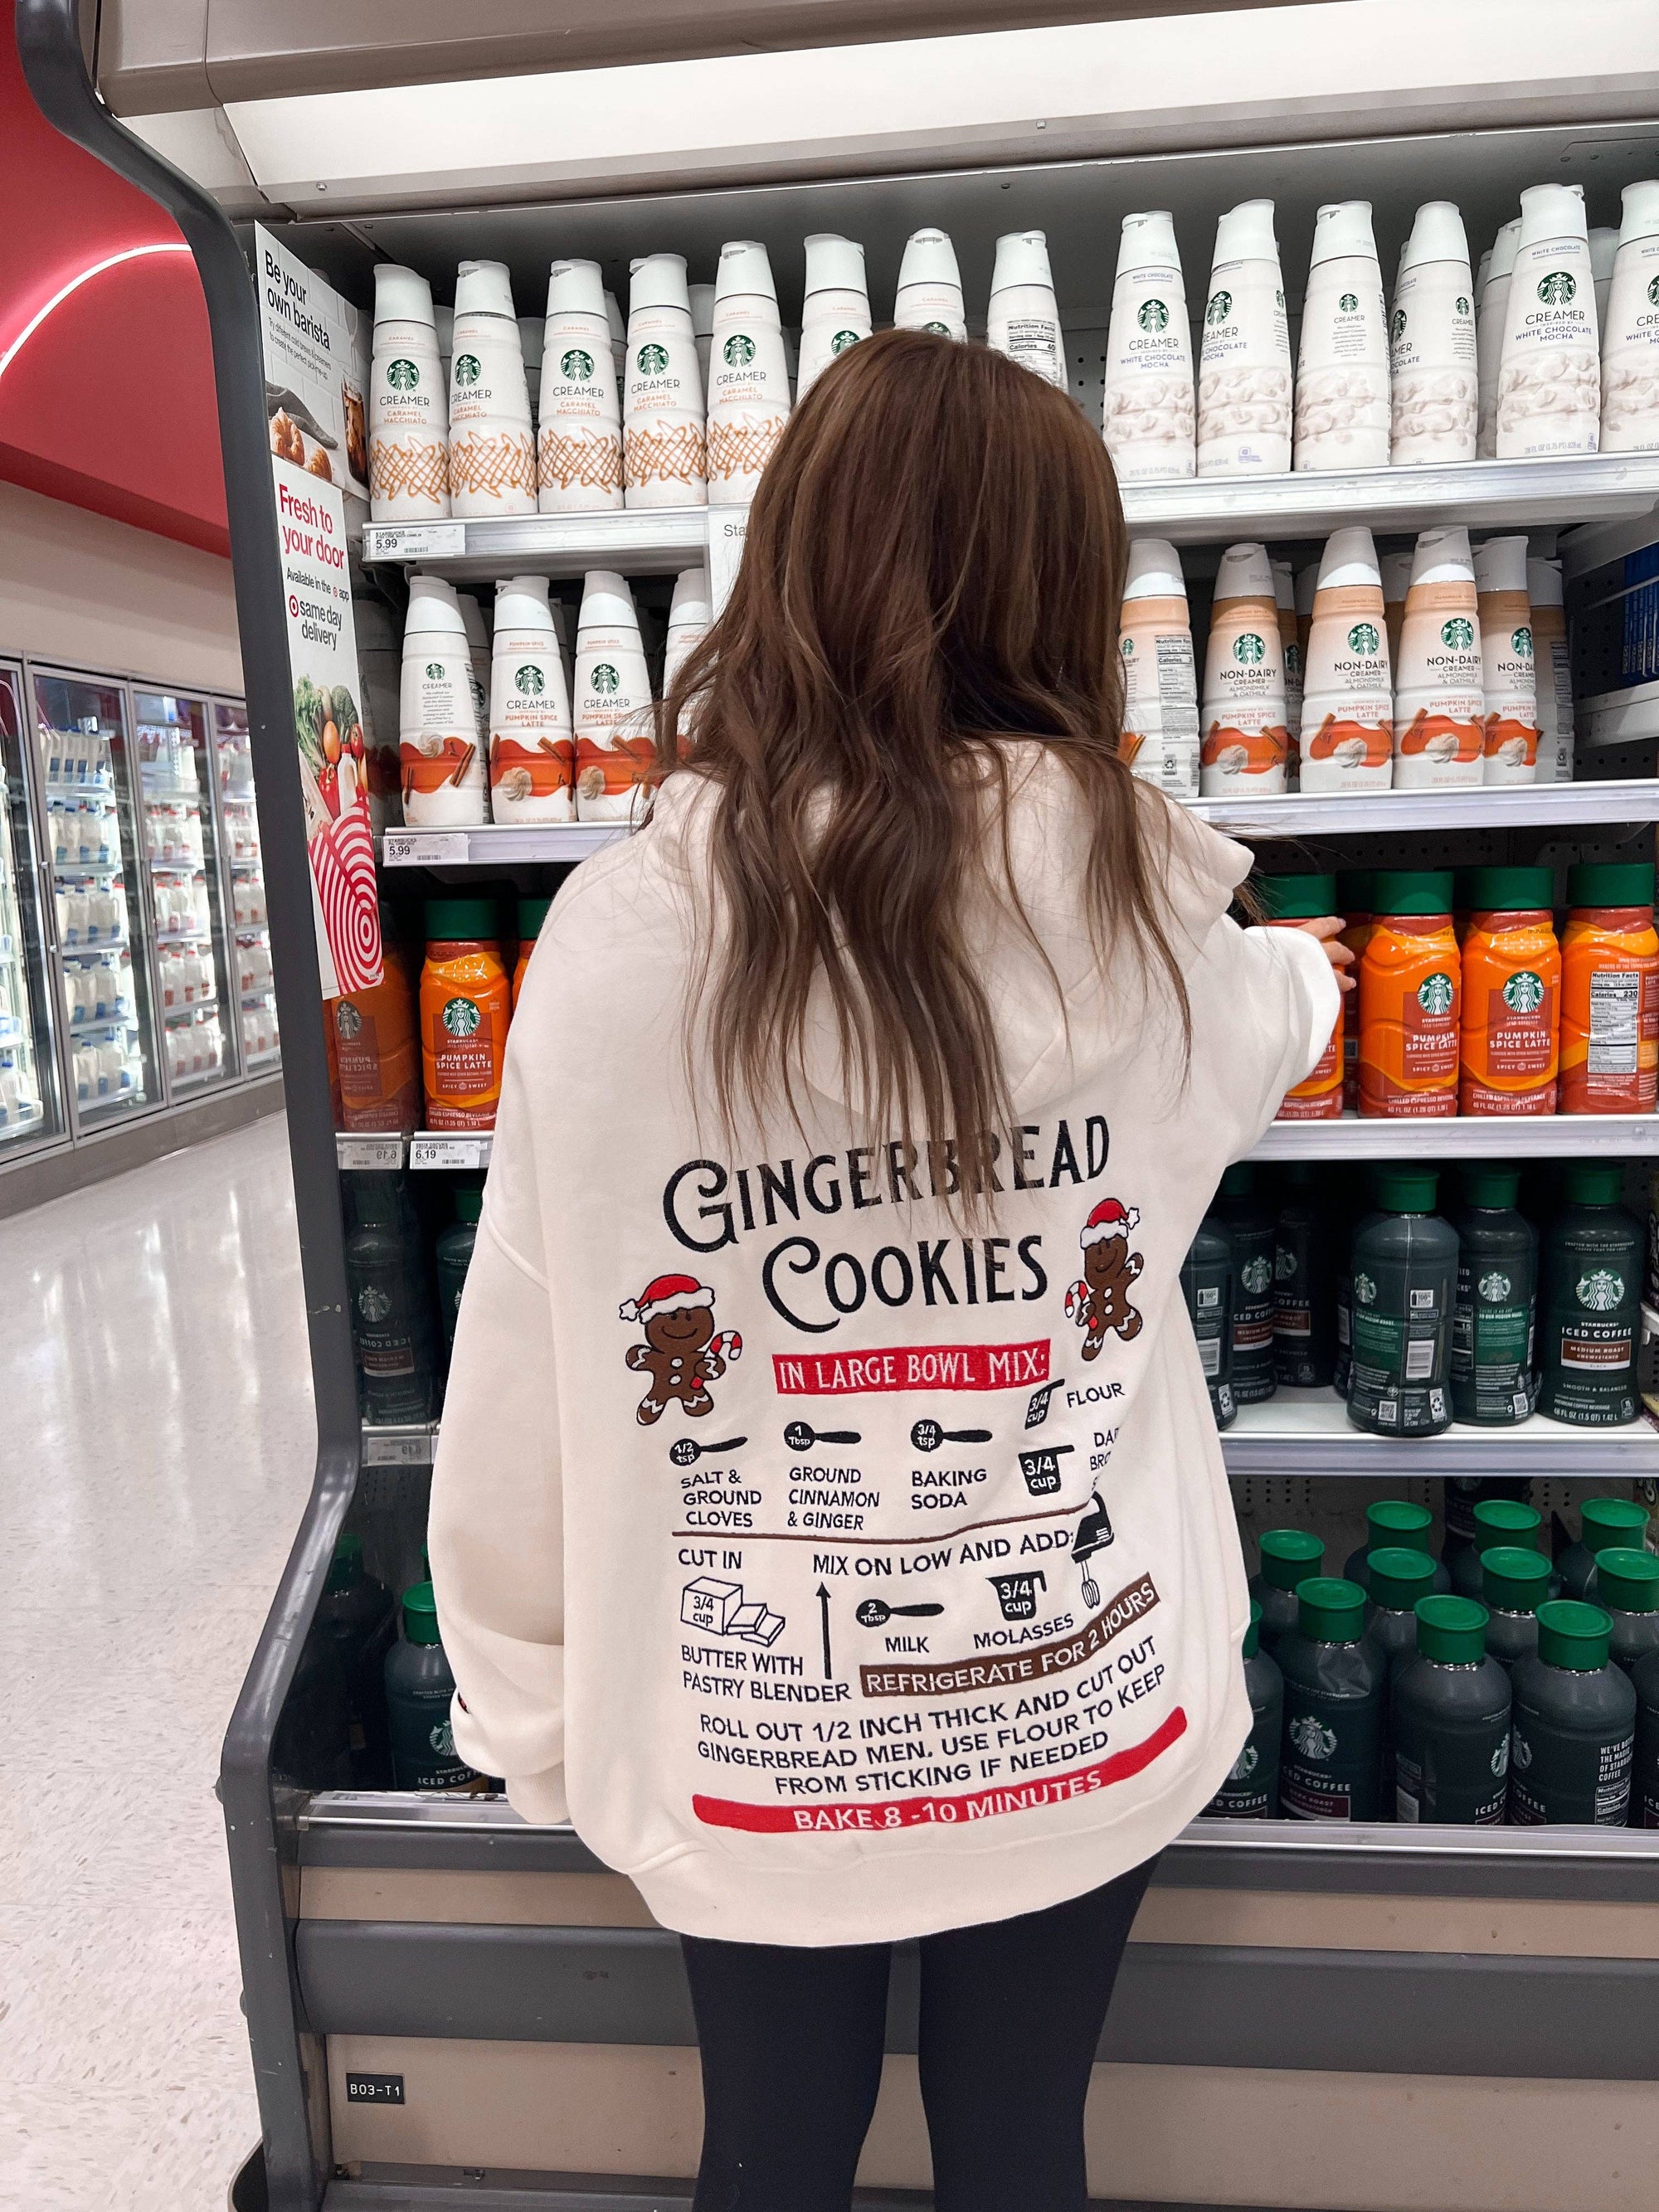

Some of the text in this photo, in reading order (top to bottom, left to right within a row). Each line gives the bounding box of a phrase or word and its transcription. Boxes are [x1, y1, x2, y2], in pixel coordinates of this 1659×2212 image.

[265, 250, 307, 305] Be your
[267, 288, 331, 352] own barista
[1525, 310, 1585, 325] CREAMER
[1515, 326, 1592, 341] WHITE CHOCOLATE
[1540, 333, 1574, 342] MOCHA
[1129, 338, 1179, 351] CREAMER
[1121, 354, 1185, 364] WHITE CHOCOLATE
[716, 372, 766, 386] CREAMER
[552, 386, 604, 398] CREAMER
[631, 379, 680, 394] CREAMER
[722, 386, 757, 396] CARAMEL
[380, 396, 430, 406] CREAMER
[719, 393, 762, 405] MACCHIATO
[557, 408, 601, 416] MACCHIATO
[279, 483, 333, 534] Fresh to
[724, 524, 747, 537] Sta
[282, 525, 344, 570] your door
[376, 538, 397, 549] 5.99
[287, 567, 349, 604] Available in the app
[299, 600, 342, 631] same day
[301, 620, 337, 651] delivery
[1220, 669, 1277, 680] NON-DAIRY
[506, 700, 555, 710] CREAMER
[389, 845, 411, 855] 5.99
[1496, 1031, 1546, 1040] PUMPKIN
[1489, 1038, 1550, 1048] SPICE LATTE
[441, 1053, 485, 1062] PUMPKIN
[464, 1061, 492, 1069] LATTE
[416, 1150, 436, 1159] 6.19
[761, 1234, 1048, 1334] COOKIES
[1561, 1327, 1632, 1338] ICED COFFEE
[779, 1347, 1047, 1390] IN LARGE BOWL MIX:
[1563, 1383, 1590, 1391] SMOOTH
[1030, 1383, 1126, 1409] 3/4 FLOUR
[1027, 1410, 1045, 1423] cup
[795, 1425, 802, 1437] 1
[917, 1423, 937, 1437] 3/4
[674, 1442, 694, 1454] 1/2
[788, 1436, 810, 1446] Tbsp
[917, 1436, 936, 1449] tsp
[676, 1453, 695, 1464] tsp
[1024, 1456, 1056, 1475] 3/4
[680, 1470, 742, 1489] SALT &
[789, 1466, 861, 1484] GROUND
[912, 1468, 987, 1487] BAKING
[1030, 1475, 1057, 1490] cup
[683, 1490, 761, 1505] GROUND
[788, 1489, 879, 1508] CINNAMON
[912, 1492, 968, 1510] SODA
[686, 1511, 753, 1528] CLOVES
[787, 1512, 864, 1530] & GINGER
[679, 1548, 742, 1569] CUT IN
[813, 1553, 849, 1576] MIX
[854, 1558, 892, 1576] ON
[900, 1548, 952, 1574] LOW
[959, 1539, 1011, 1564] AND
[1000, 1580, 1033, 1600] 3/4
[693, 1596, 714, 1611] 3/4
[868, 1602, 878, 1613] 2
[1005, 1601, 1033, 1616] cup
[693, 1613, 713, 1627] cup
[861, 1614, 886, 1623] Tbsp
[866, 1581, 1155, 1693] REFRIGERATE FOR 2 HOURS
[974, 1613, 1074, 1649] MOLASSES
[885, 1636, 929, 1653] MILK
[681, 1645, 803, 1675] BUTTER WITH
[683, 1670, 853, 1702] PASTRY BLENDER
[700, 1636, 1156, 1743] ROLL OUT 1/2 INCH THICK AND CUT OUT
[698, 1663, 1165, 1769] GINGERBREAD MEN. USE FLOUR TO KEEP
[1601, 1743, 1620, 1755] WE'VE
[775, 1731, 1109, 1795] FROM STICKING IF NEEDED
[1600, 1754, 1613, 1763] THE
[1600, 1764, 1608, 1772] OF
[1598, 1769, 1621, 1782] COFFEE
[1305, 1778, 1351, 1791] COFFEE
[793, 1808, 872, 1830] BAKE
[883, 1806, 902, 1828] 8
[966, 1770, 1102, 1821] MINUTES
[1228, 1794, 1268, 1808] COFFEE
[350, 2083, 400, 2097] B03-T1
